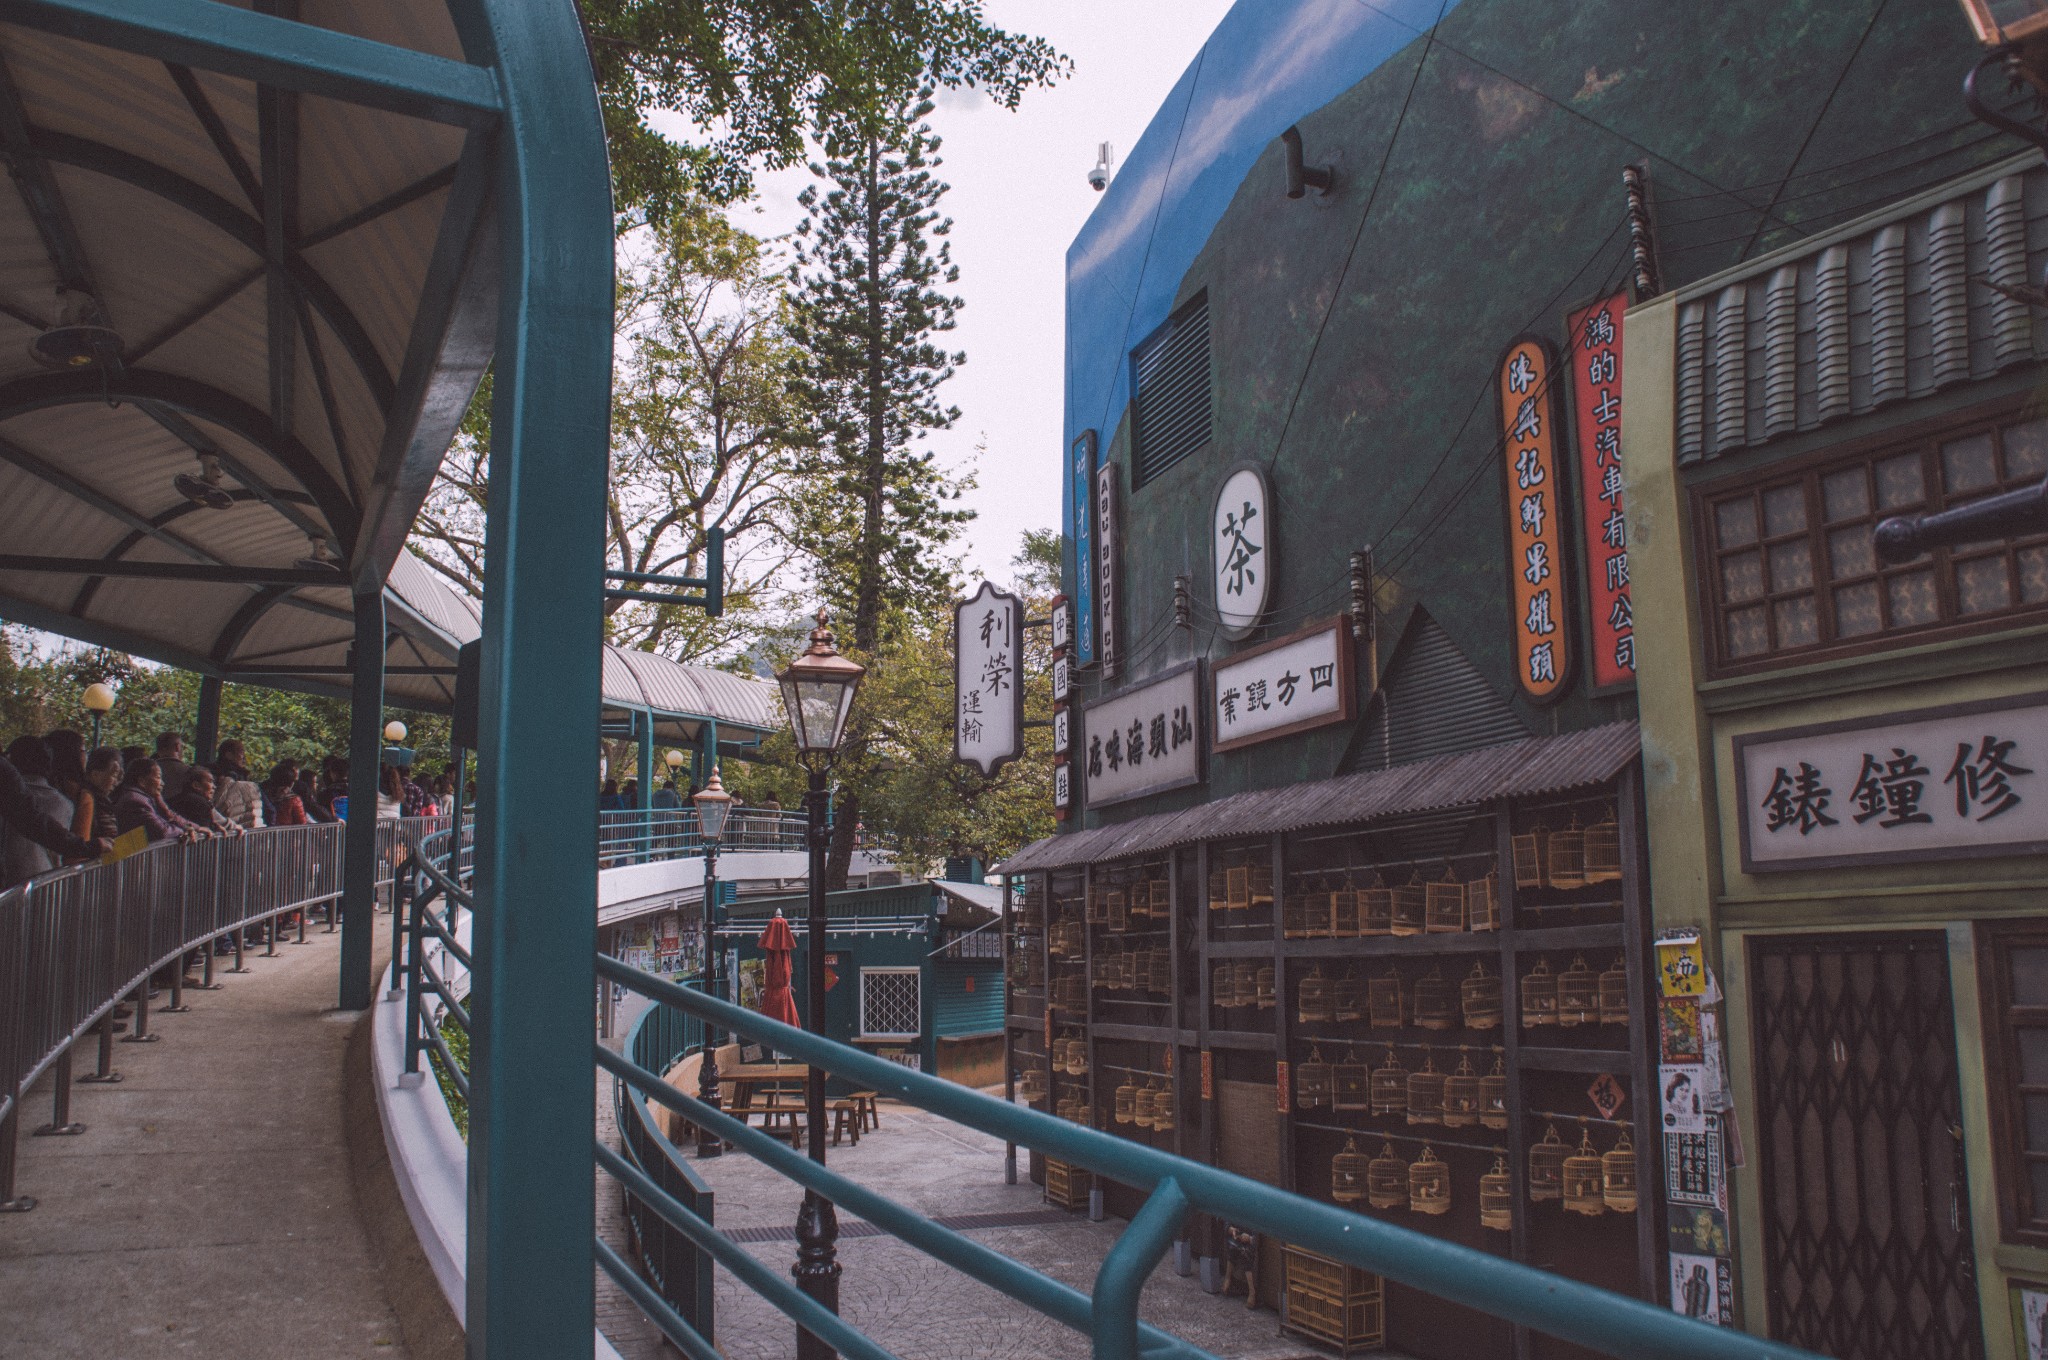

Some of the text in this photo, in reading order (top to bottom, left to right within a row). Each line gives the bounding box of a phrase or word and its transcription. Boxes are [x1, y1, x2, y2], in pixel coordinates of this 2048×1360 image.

[1100, 478, 1109, 532] ABC
[1102, 547, 1110, 619] BOOK
[1221, 502, 1263, 597] 茶
[979, 606, 1012, 697] 利榮
[961, 690, 984, 744] 運輸
[1055, 613, 1069, 801] 中國皮鞋
